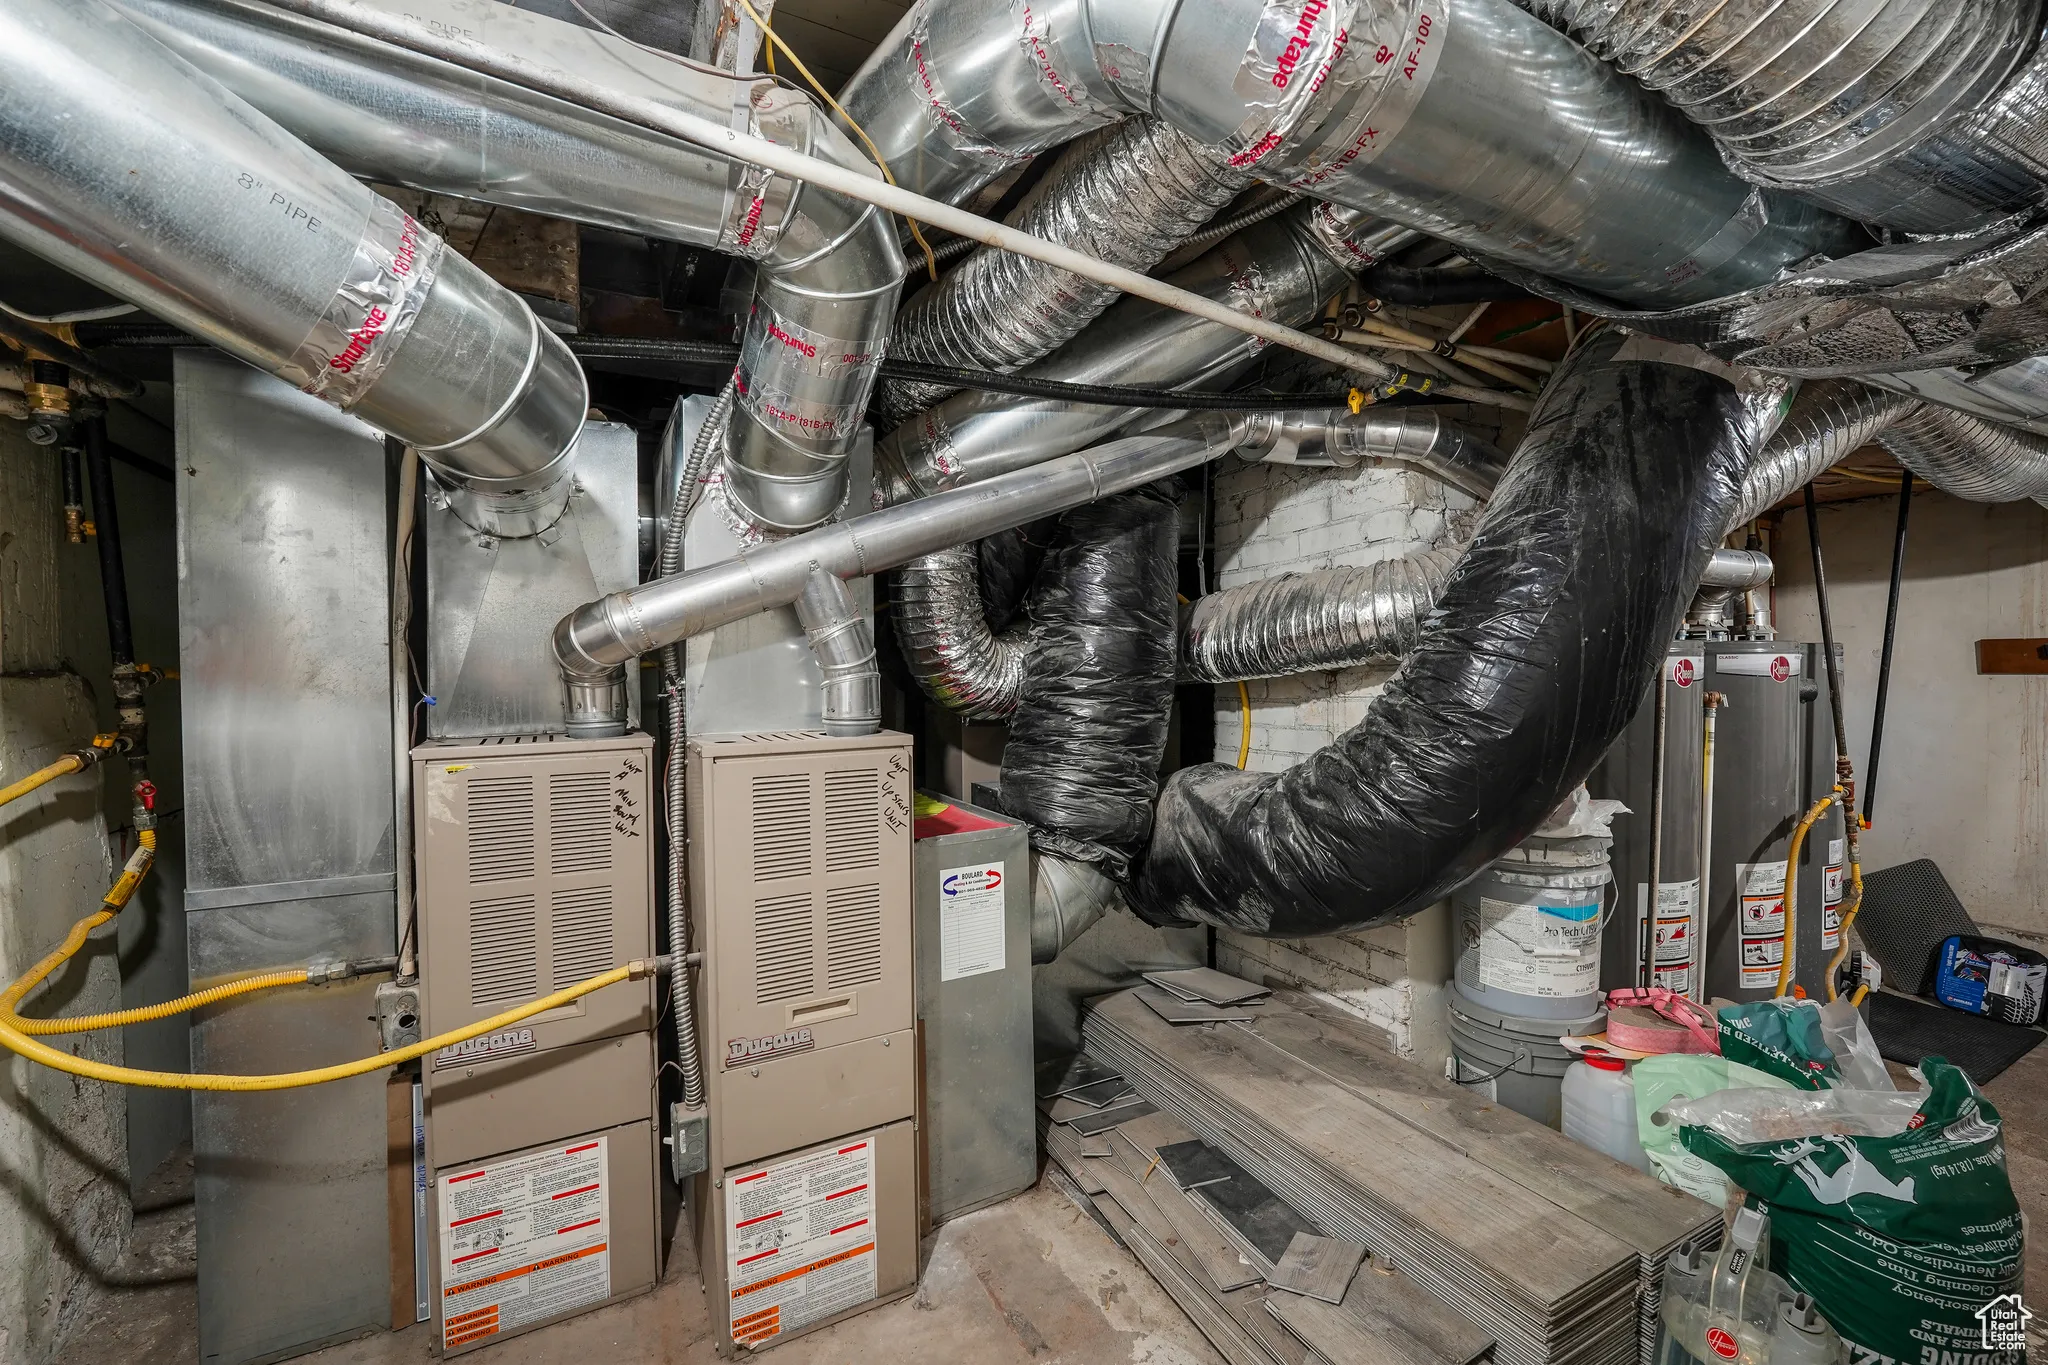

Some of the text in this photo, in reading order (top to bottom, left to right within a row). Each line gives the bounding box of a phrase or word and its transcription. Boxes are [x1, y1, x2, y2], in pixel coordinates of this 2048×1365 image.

[1403, 14, 1432, 80] AF-100
[237, 172, 322, 234] 8" PIPE
[330, 305, 387, 374] Shurtape
[768, 323, 816, 358] Shurtape
[1676, 660, 1695, 683] Rheem
[1772, 656, 1790, 679] Rheem
[961, 870, 984, 880] BOULARD
[1543, 926, 1559, 937] Pro
[1560, 926, 1579, 938] Tech
[440, 1029, 534, 1060] Ducane
[728, 1027, 812, 1059] Ducane
[545, 1151, 565, 1159] OPERATING
[1930, 1164, 1951, 1179] kg)
[1949, 1157, 1974, 1173] (18.14
[504, 1205, 525, 1213] OPERATING
[1961, 1215, 2013, 1236] Perfumes
[537, 1231, 557, 1240] APPLIANCE
[1855, 1228, 1898, 1255] Odor
[542, 1252, 579, 1268] WARNING
[817, 1253, 850, 1269] WARNING
[1730, 1252, 1740, 1271] CARRY
[1735, 1252, 1747, 1274] HANDLE
[1904, 1249, 1997, 1278] Neutralizes
[1877, 1258, 1919, 1282] Time
[457, 1276, 497, 1293] WARNING
[743, 1278, 778, 1294] WARNING
[1925, 1275, 1995, 1296] Cleaning
[456, 1308, 491, 1323] WARNING
[742, 1310, 772, 1325] WARNING
[456, 1318, 491, 1333] WARNING
[742, 1319, 772, 1335] WARNING
[456, 1328, 491, 1343] WARNING
[748, 1329, 773, 1343] ARNING
[1909, 1329, 1949, 1345] AND
